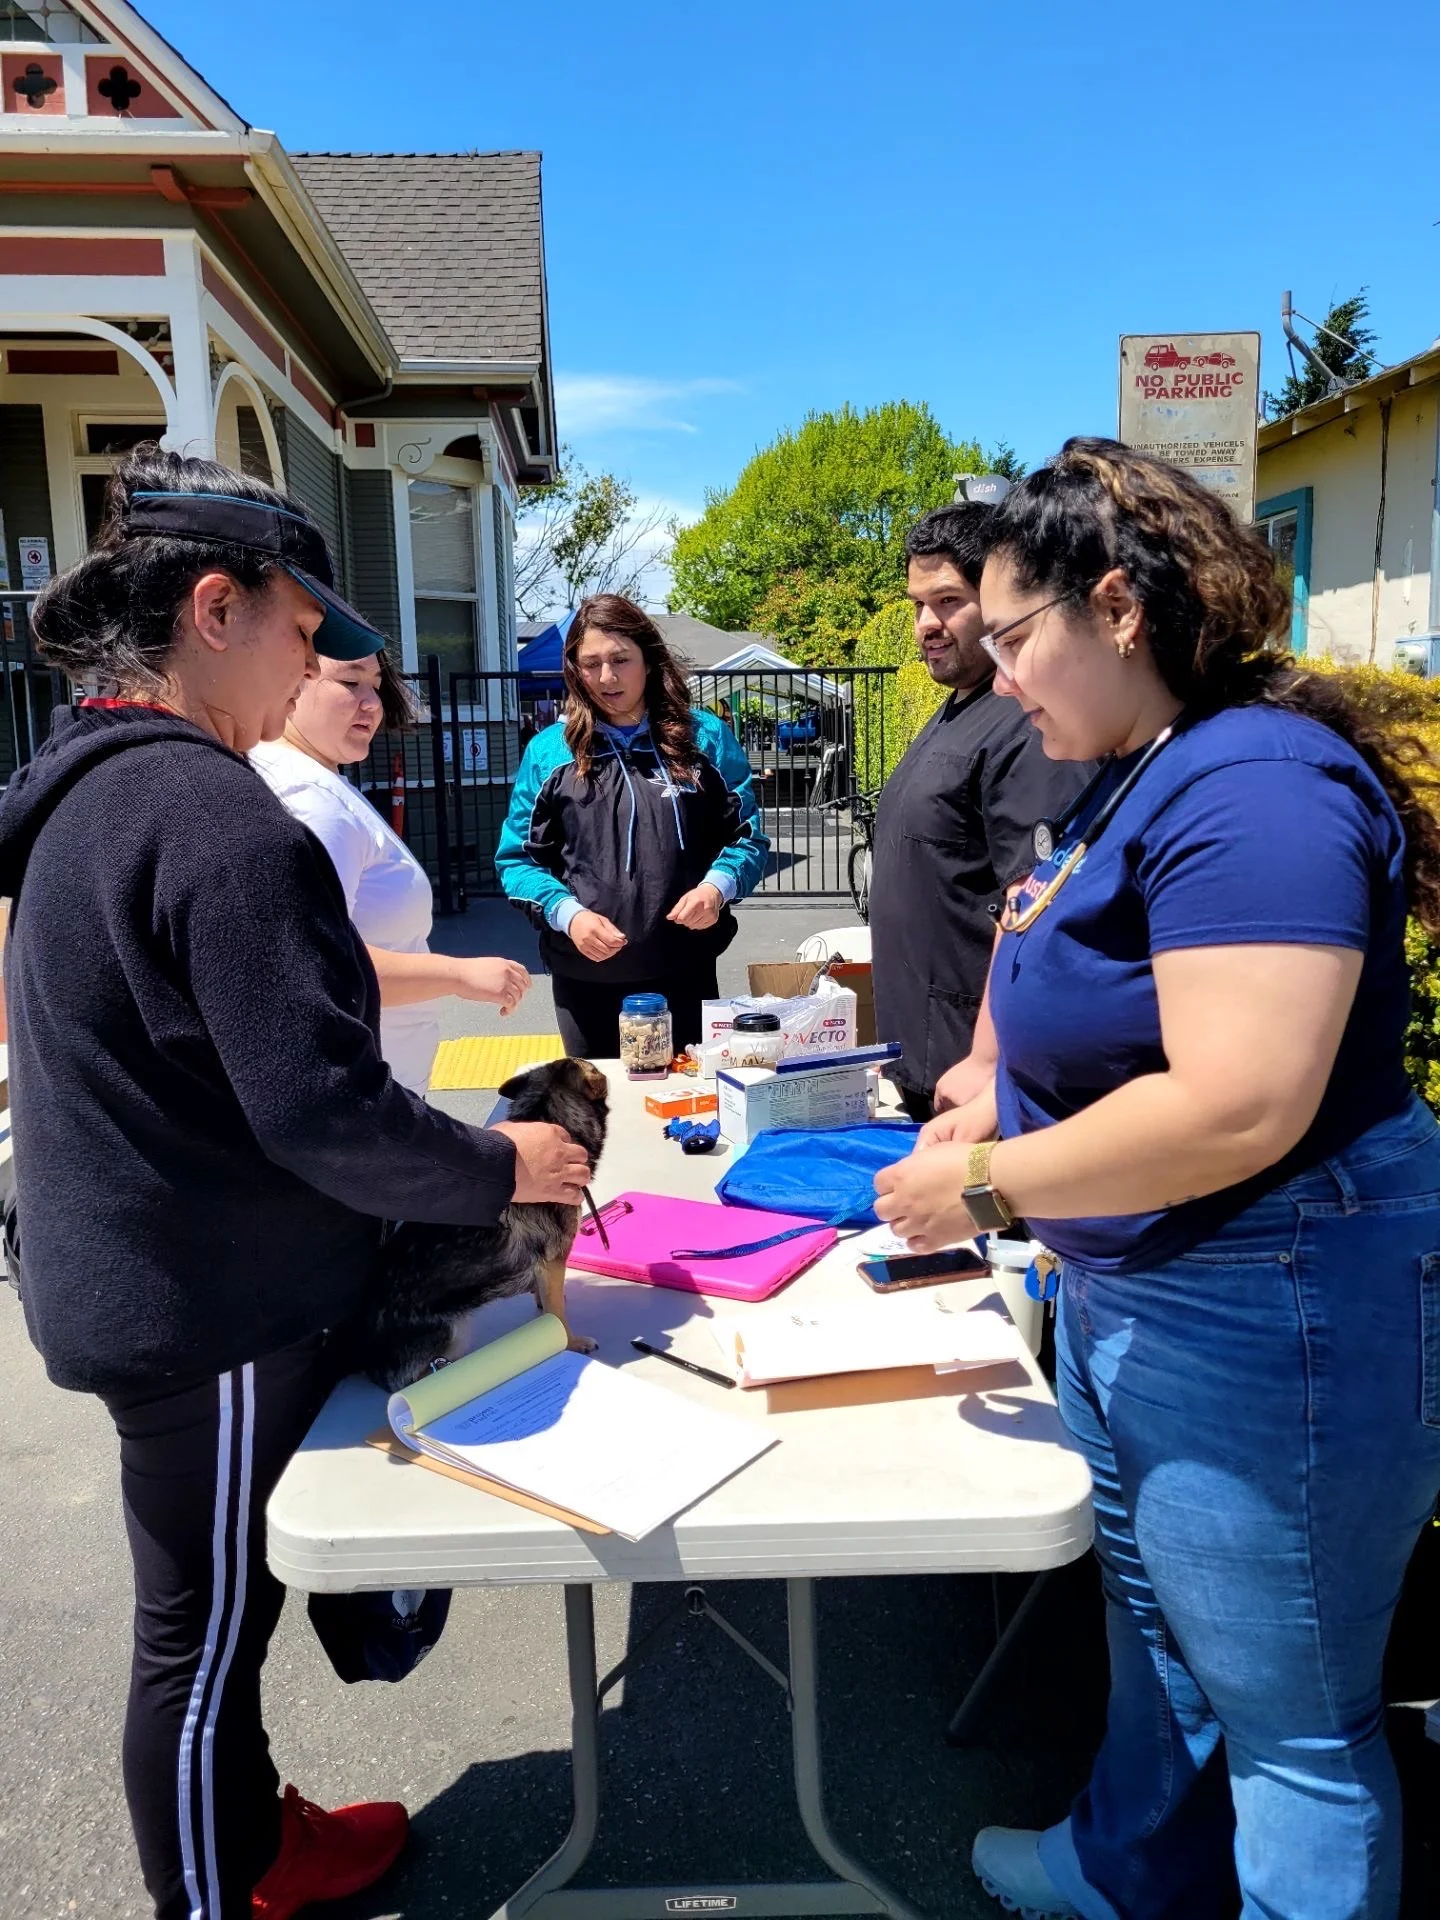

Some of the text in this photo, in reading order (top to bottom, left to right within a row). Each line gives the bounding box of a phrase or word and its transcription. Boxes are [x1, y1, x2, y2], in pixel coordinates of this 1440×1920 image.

[1135, 372, 1244, 387] NO PUBLIC
[1144, 386, 1232, 399] PARKING
[973, 483, 997, 493] dish
[674, 1899, 729, 1908] LIFETIME
